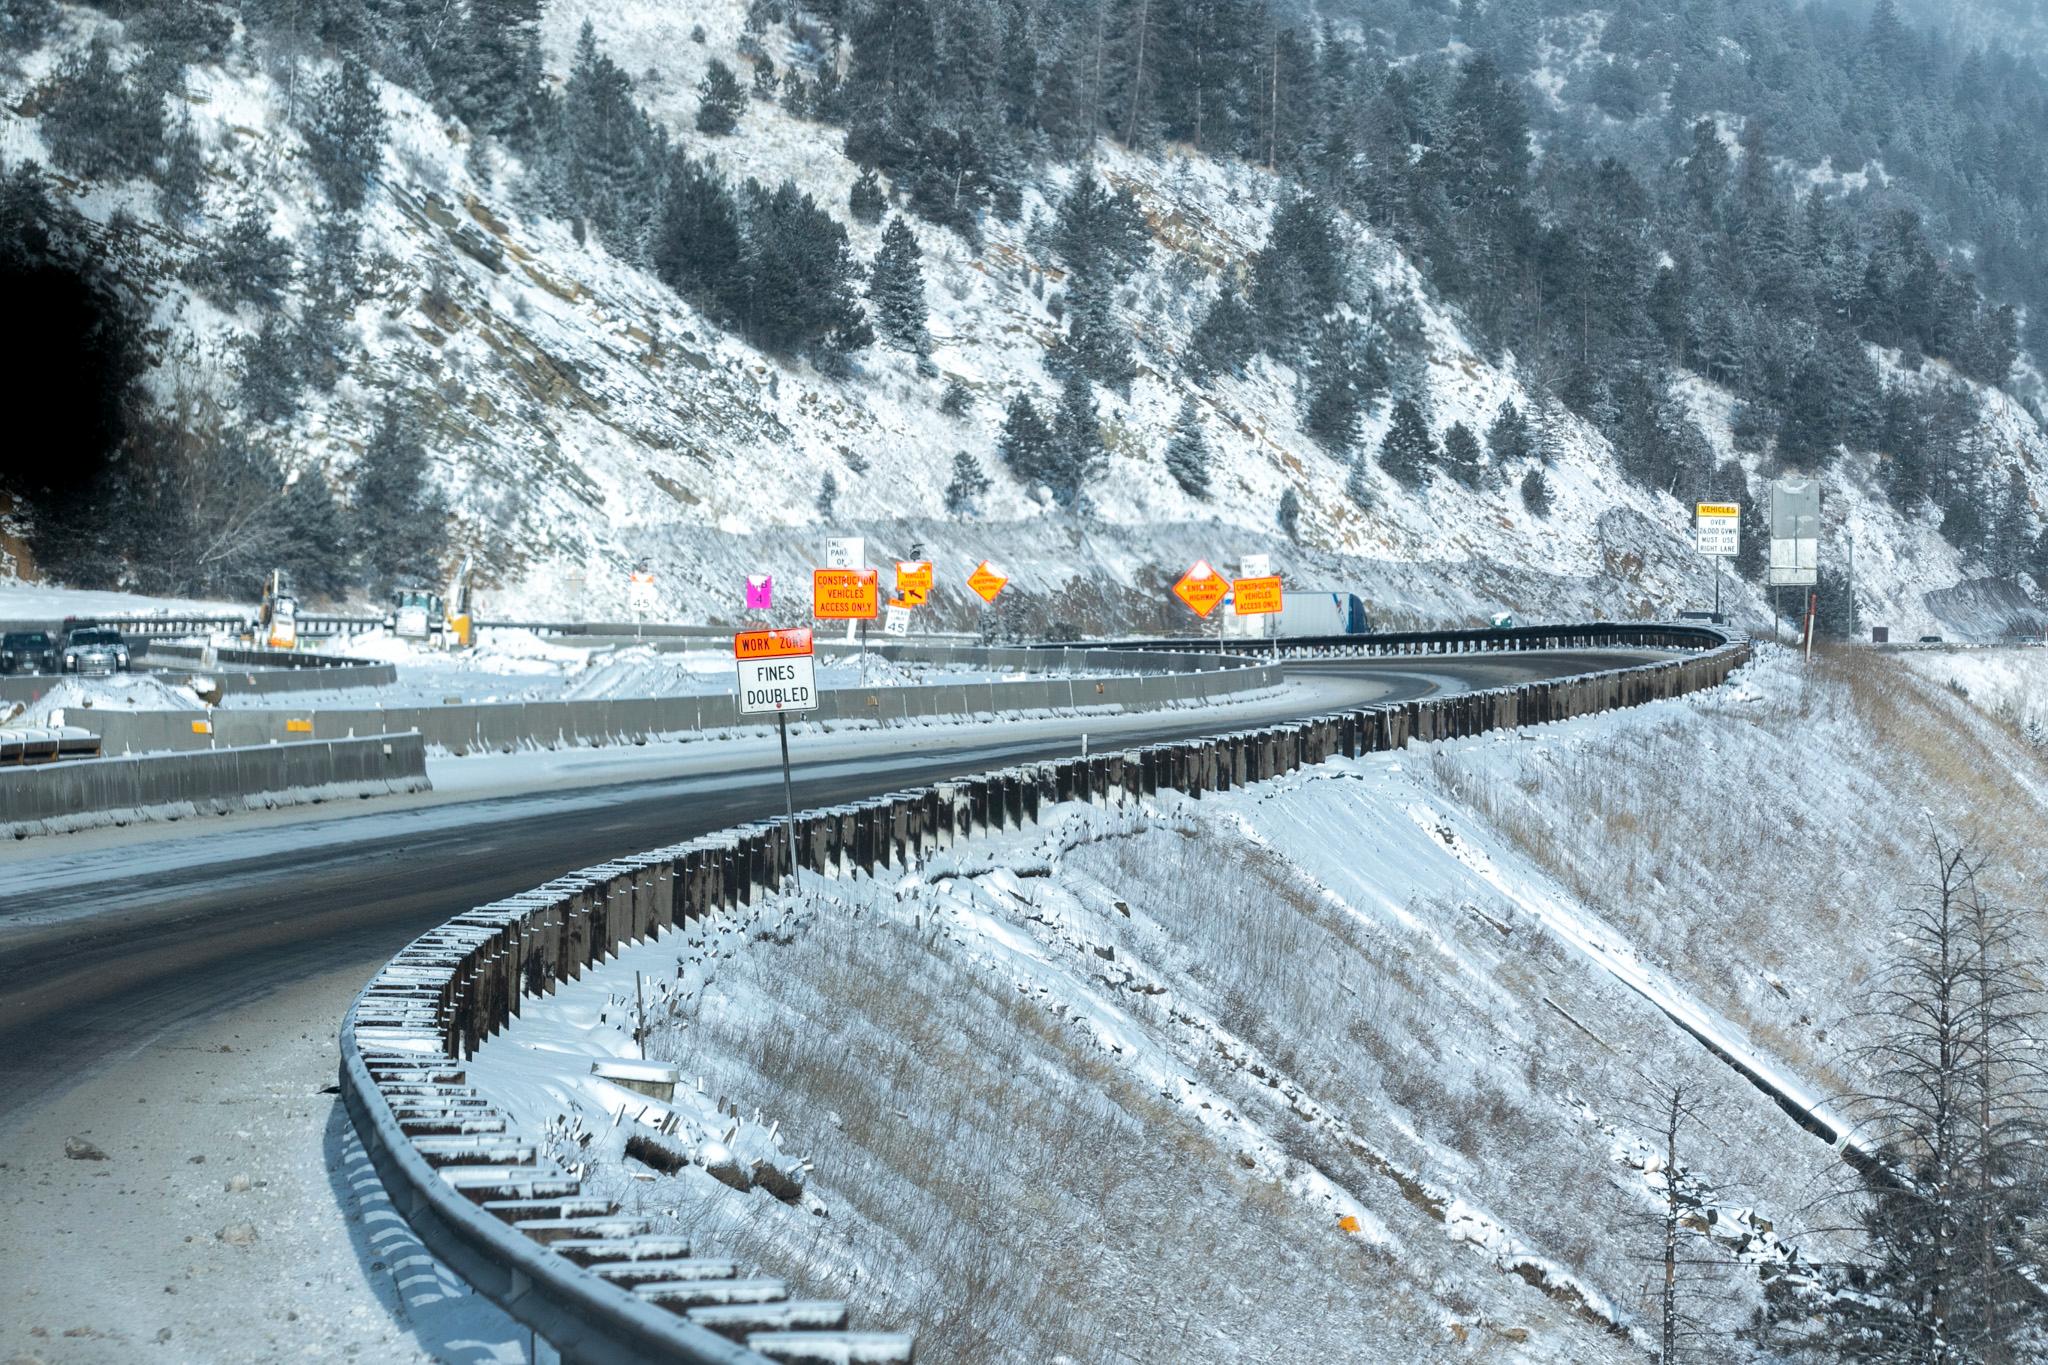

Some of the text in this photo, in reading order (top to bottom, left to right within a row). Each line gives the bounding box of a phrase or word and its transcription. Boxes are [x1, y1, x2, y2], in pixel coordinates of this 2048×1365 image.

[1237, 582, 1279, 592] CONSTRUCTION
[827, 589, 864, 599] VEHICLES
[1244, 592, 1272, 600] VEHICLES
[820, 602, 872, 612] ACCESS ONLY
[1239, 601, 1279, 610] ACCESS ONLY
[888, 623, 905, 633] 45
[742, 638, 770, 651] WORK
[757, 665, 795, 682] FINES
[747, 687, 809, 705] DOUBLED
